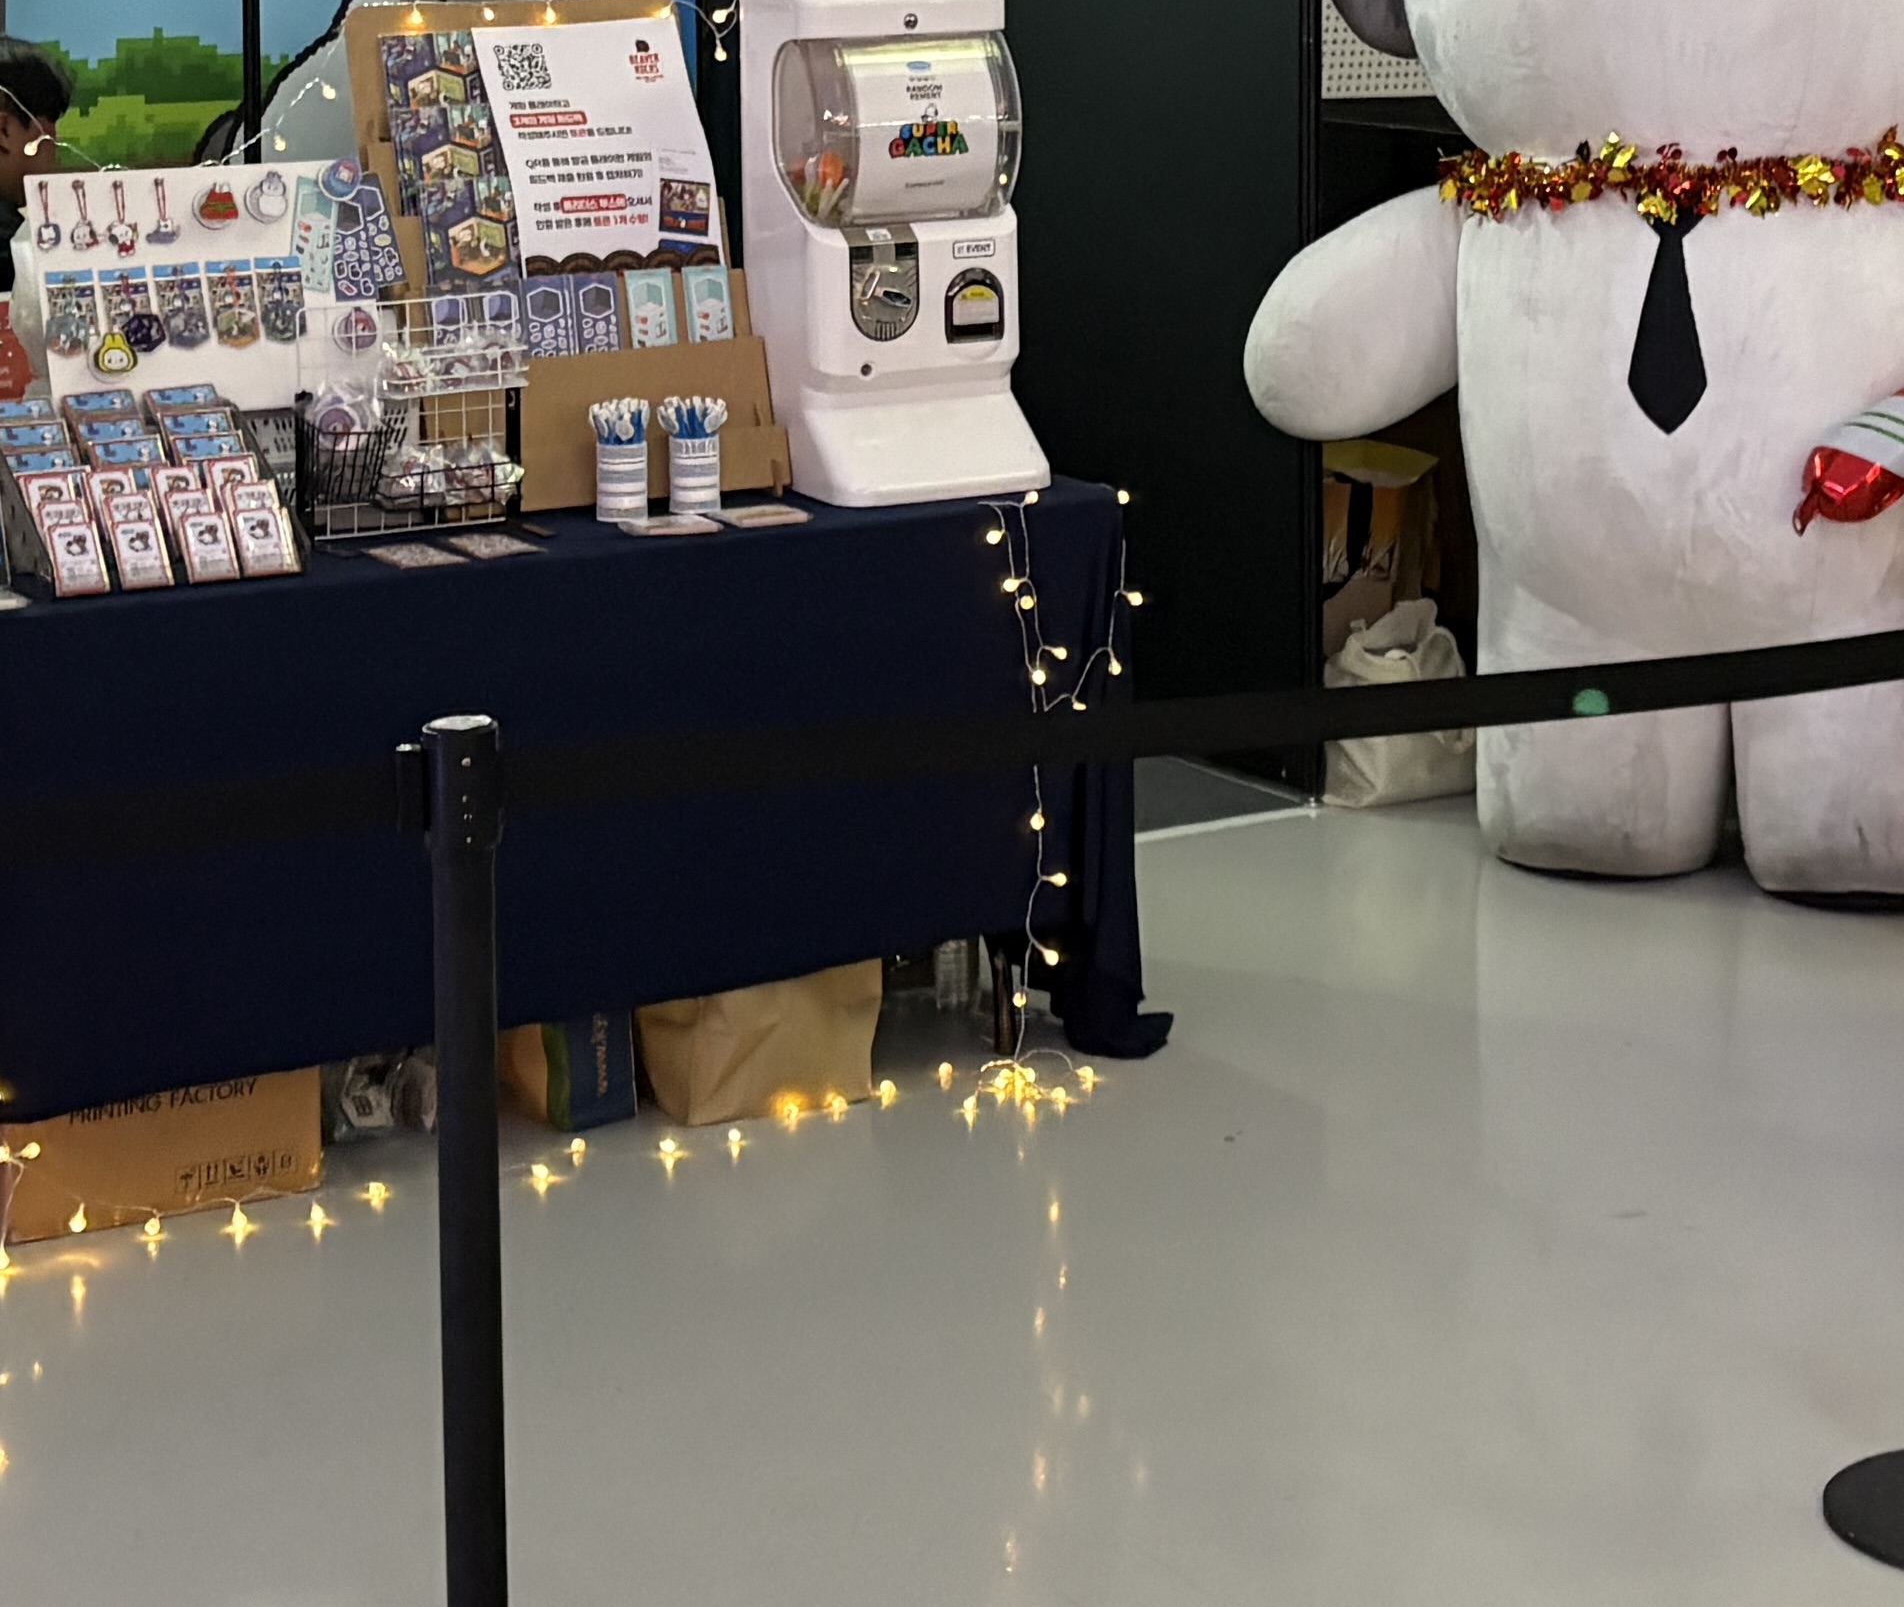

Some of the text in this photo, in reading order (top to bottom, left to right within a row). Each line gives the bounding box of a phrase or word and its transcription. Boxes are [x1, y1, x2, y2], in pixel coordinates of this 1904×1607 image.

[889, 134, 969, 159] GACHA
[69, 1078, 258, 1124] PRINTING FACTORY
